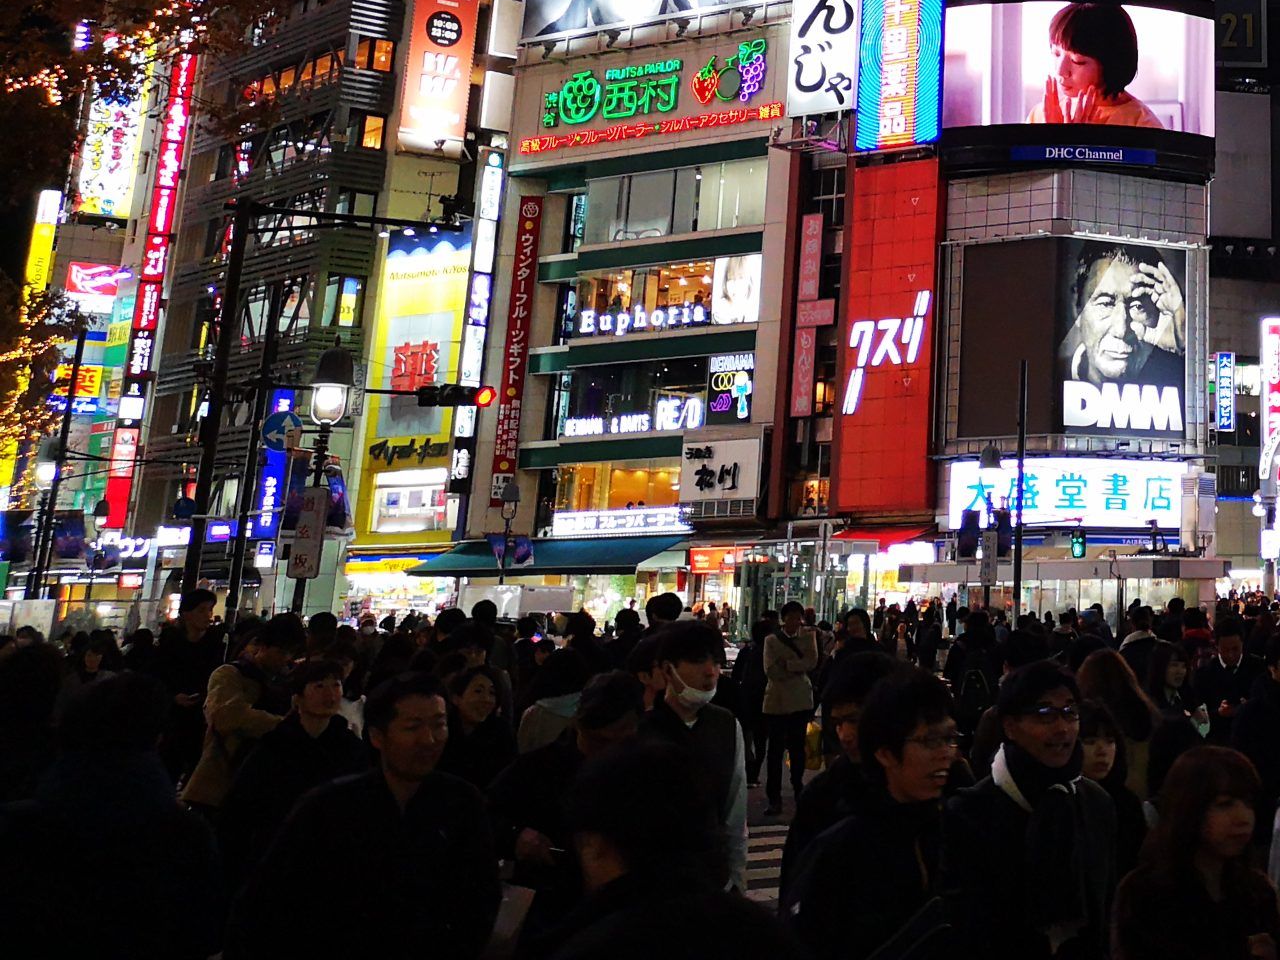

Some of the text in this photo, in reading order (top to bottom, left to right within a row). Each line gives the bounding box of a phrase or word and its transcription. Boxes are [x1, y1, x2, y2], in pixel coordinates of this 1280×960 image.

[1220, 13, 1253, 48] 21
[543, 92, 558, 127] 渋谷
[602, 75, 679, 119] 西村
[1045, 146, 1123, 161] DHC Channel
[507, 233, 535, 384] ウィンターフルーツギフト
[579, 302, 705, 336] Euphoria
[1062, 379, 1184, 431] DMM
[619, 413, 650, 433] DARTS
[966, 472, 1173, 512] 大盛堂書店
